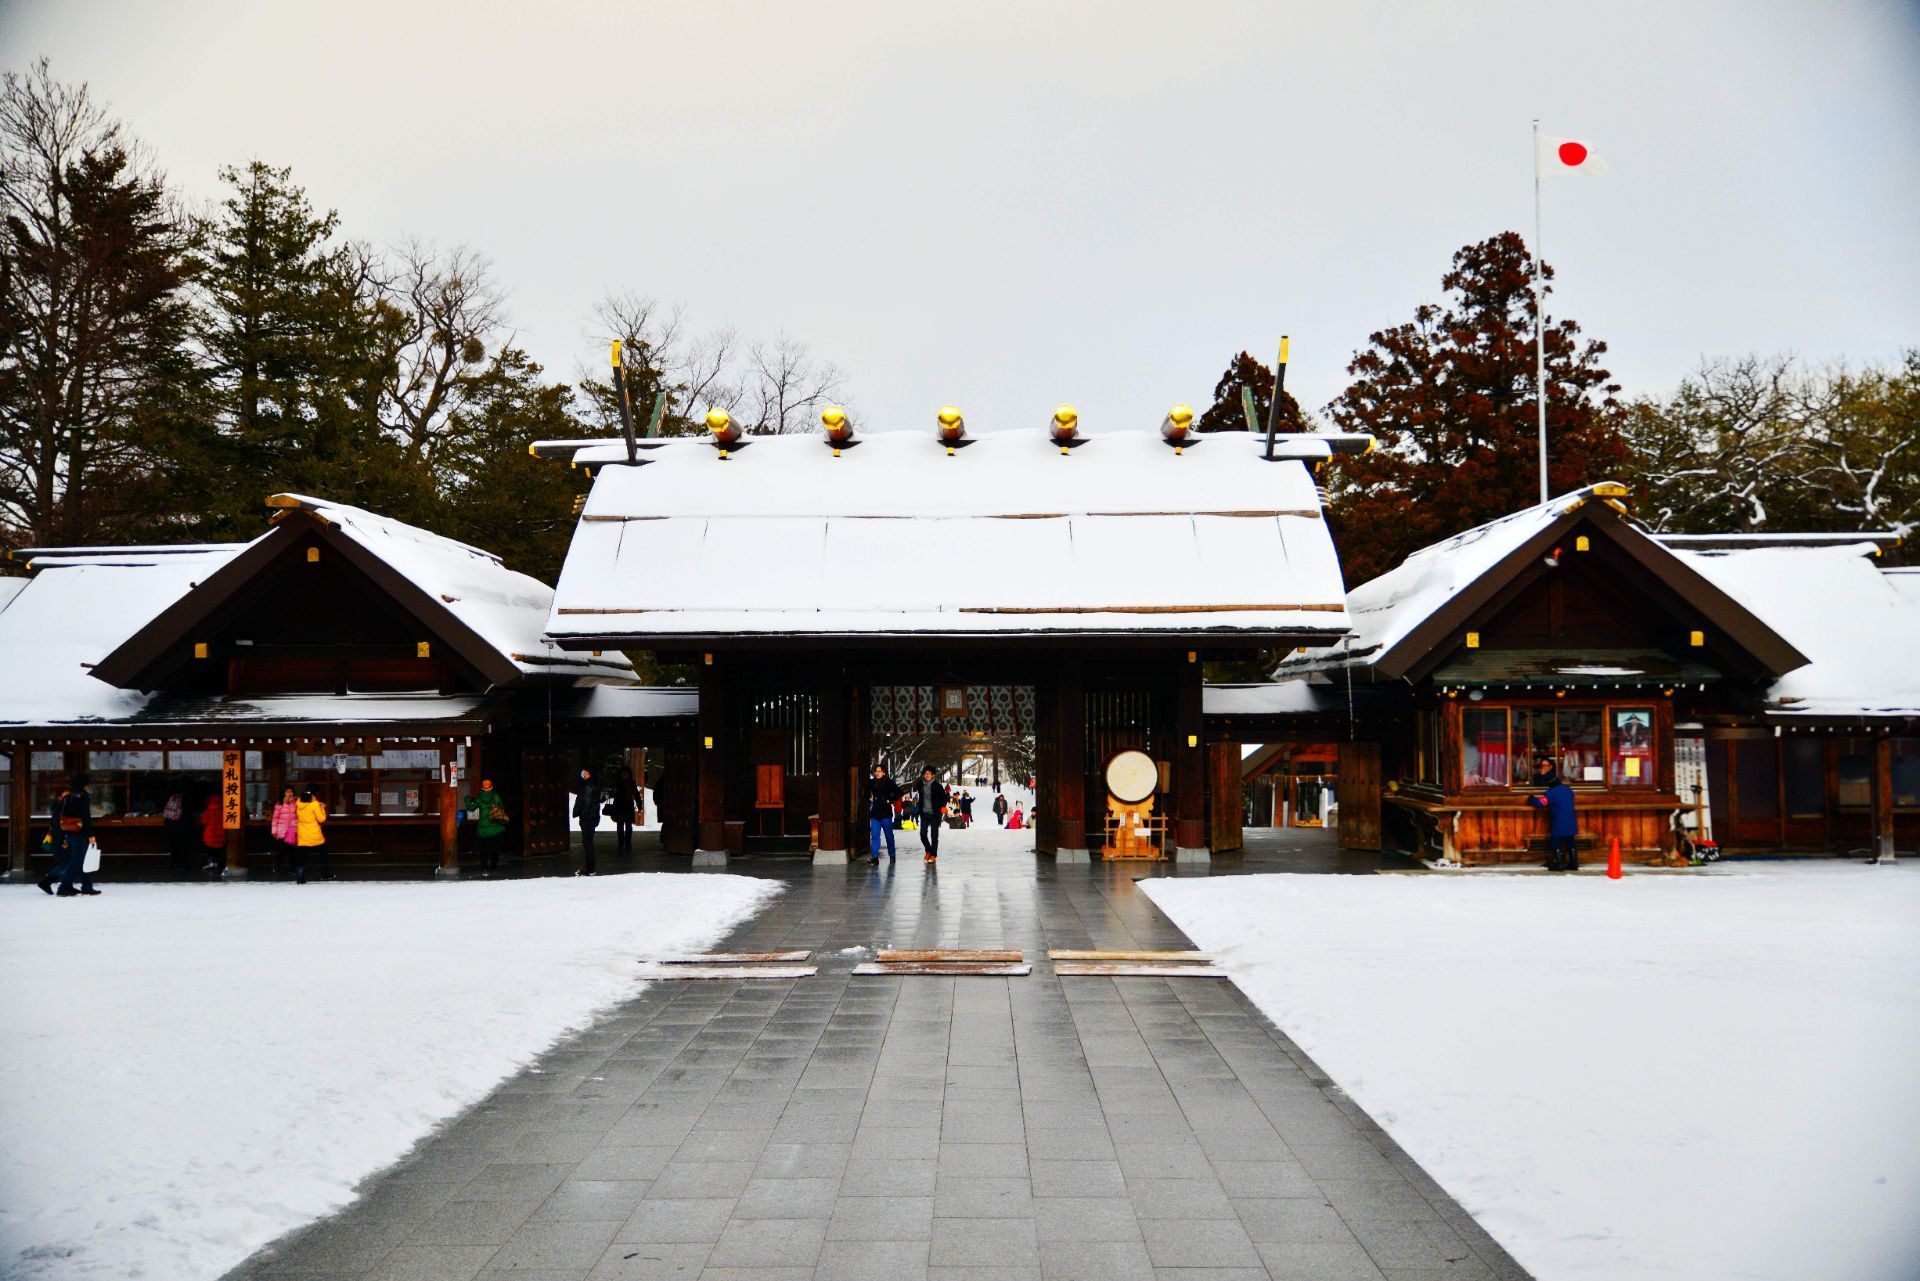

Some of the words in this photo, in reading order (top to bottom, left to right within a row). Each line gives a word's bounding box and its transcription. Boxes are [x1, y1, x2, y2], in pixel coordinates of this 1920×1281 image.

[225, 753, 239, 825] 守札授与所
